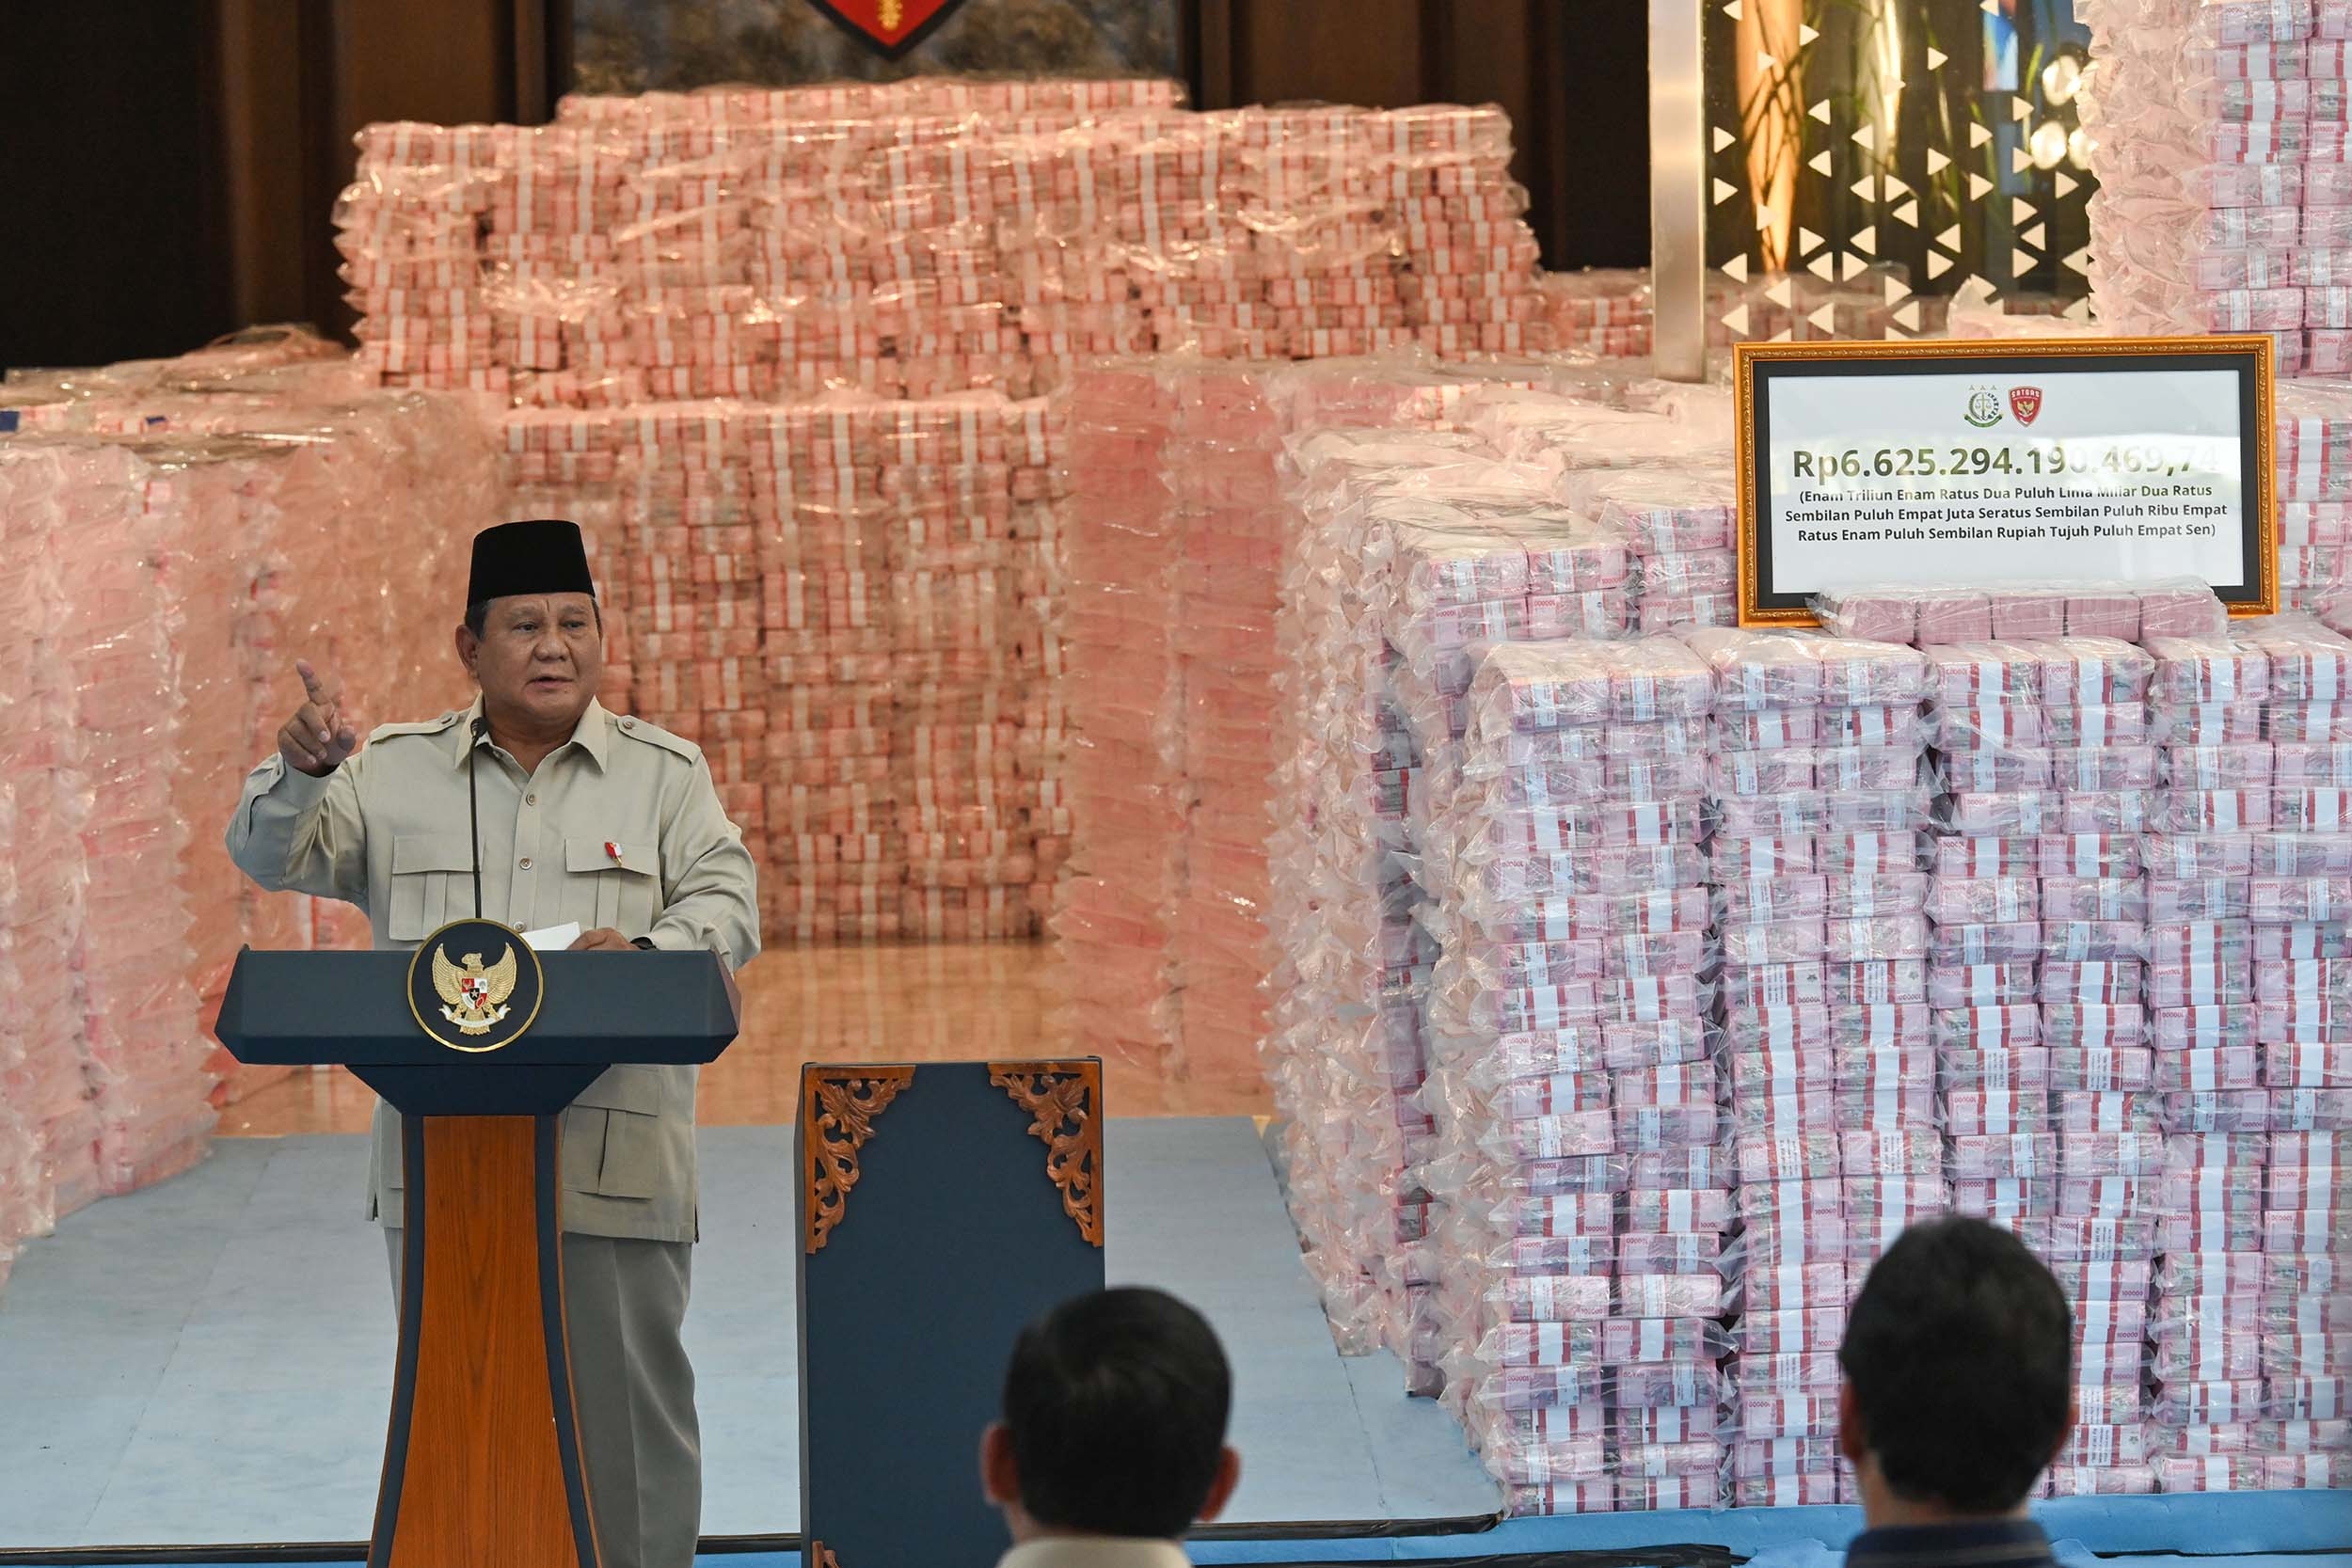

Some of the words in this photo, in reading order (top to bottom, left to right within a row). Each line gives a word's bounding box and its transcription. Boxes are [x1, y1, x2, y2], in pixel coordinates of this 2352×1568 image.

[1799, 490, 1844, 504] (Enam
[1847, 489, 1893, 501] Triliun
[1897, 489, 1935, 500] Enam
[1940, 488, 1979, 499] Ratus
[1983, 488, 2010, 499] Dua
[2014, 486, 2055, 499] Puluh
[2141, 485, 2169, 497] Dua
[2173, 484, 2213, 496] Ratus
[1785, 510, 1850, 522] Sembilan
[1854, 509, 1894, 521] Puluh
[1899, 508, 1943, 523] Empat
[1946, 508, 1975, 522] Juta
[1979, 507, 2031, 518] Seratus
[2035, 505, 2099, 517] Sembilan
[2104, 504, 2143, 516] Puluh
[2148, 504, 2179, 515] Ribu
[2183, 503, 2228, 518] Empat
[1798, 530, 1837, 542] Ratus
[1842, 529, 1881, 541] Enam
[1884, 528, 1925, 540] Puluh
[1929, 527, 1993, 539] Sembilan
[1997, 526, 2046, 540] Rupiah
[2050, 525, 2089, 540] Tujuh
[2093, 524, 2133, 536] Puluh
[2137, 524, 2182, 538] Empat
[2185, 523, 2216, 537] Sen)
